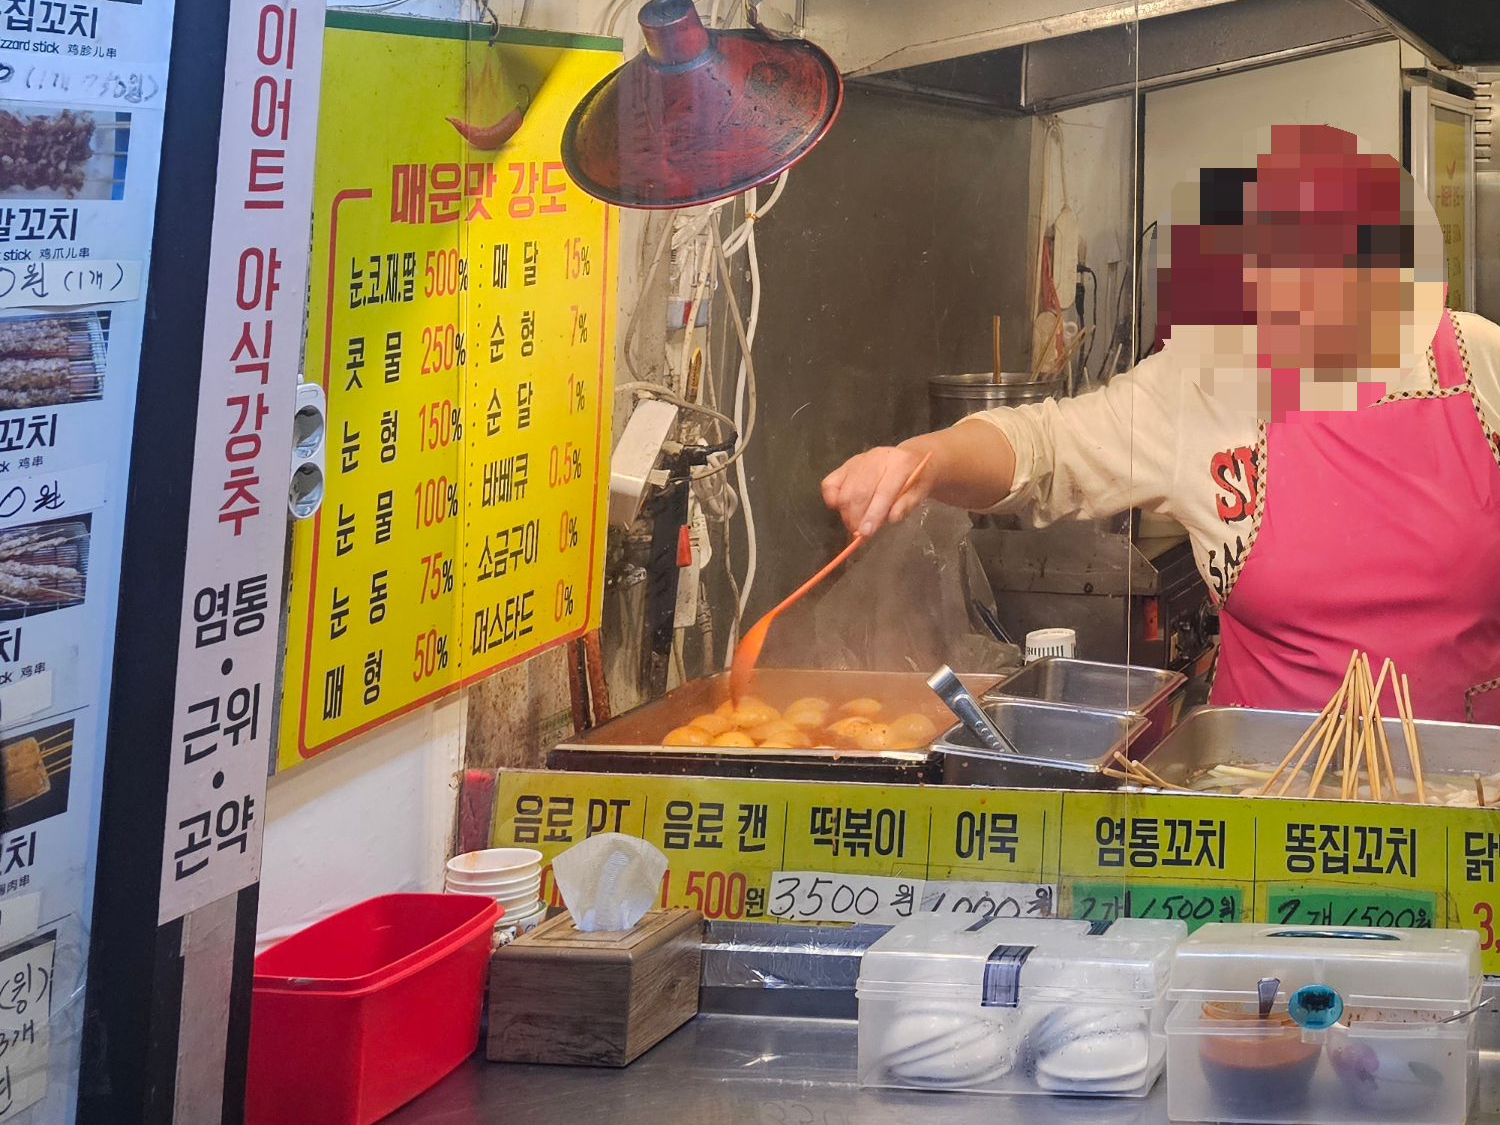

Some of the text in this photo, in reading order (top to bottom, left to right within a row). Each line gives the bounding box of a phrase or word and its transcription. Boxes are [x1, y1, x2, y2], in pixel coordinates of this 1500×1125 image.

[33, 40, 59, 54] stick
[391, 161, 567, 224] 매운맛 강도
[3, 249, 31, 261] stick
[424, 248, 468, 297] 500%
[563, 237, 590, 280] 15%
[421, 323, 466, 375] 250%
[570, 304, 588, 347] 7%
[216, 246, 282, 538] 야식강추
[567, 373, 585, 415] 1%
[418, 398, 462, 452] 150%
[481, 440, 582, 508] 바베큐 0.5%
[414, 475, 458, 530] 100%
[477, 510, 578, 583] 소금구이 0%
[420, 551, 454, 605] 75%
[193, 573, 270, 650] 염통
[472, 579, 573, 656] 머스타드 0%
[412, 628, 448, 683] 50%
[182, 682, 261, 765] 근위
[174, 793, 256, 884] 곤약
[513, 795, 631, 844] 음료 PT
[663, 800, 768, 853] 음료 캔
[810, 806, 906, 858] 떡볶이
[955, 810, 1019, 864] 어묵
[1095, 816, 1225, 869] 염통꼬치
[1285, 822, 1417, 877] 똥집꼬치
